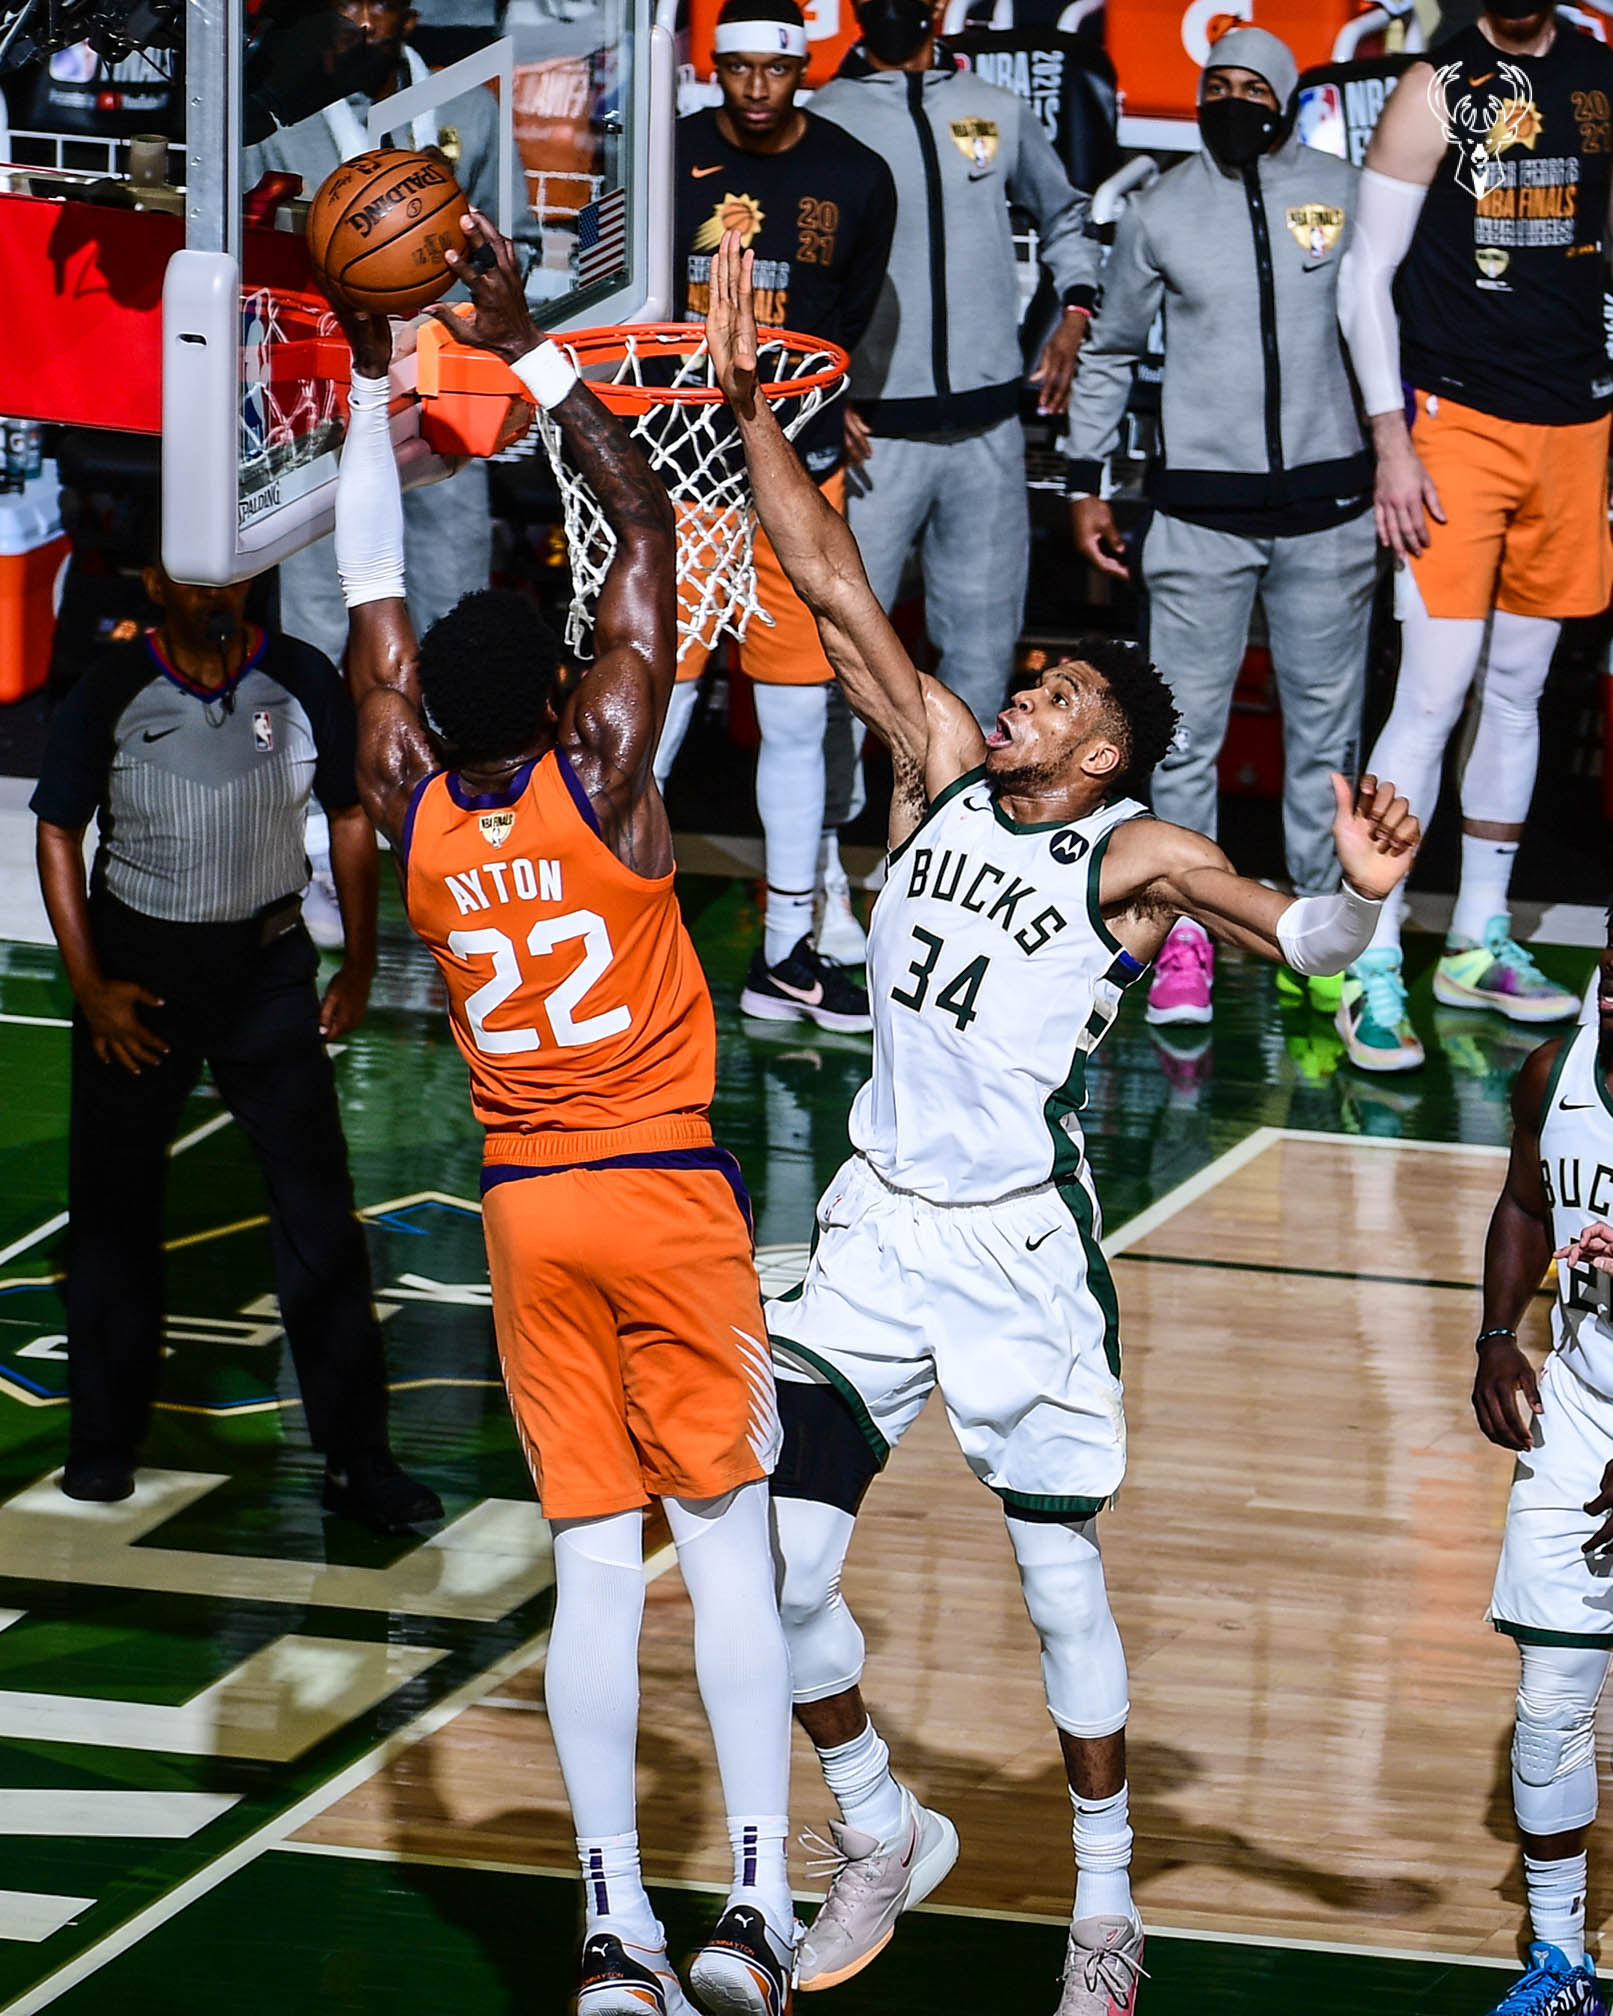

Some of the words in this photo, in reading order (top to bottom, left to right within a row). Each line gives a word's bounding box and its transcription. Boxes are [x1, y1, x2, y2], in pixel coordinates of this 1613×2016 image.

[348, 163, 448, 238] SPALDING
[797, 196, 840, 233] 20
[1517, 183, 1579, 219] FINALS
[796, 230, 836, 267] 21
[444, 857, 563, 916] AYTON
[906, 848, 1068, 957] BUCKS
[447, 908, 633, 1054] 22
[890, 924, 992, 1032] 34
